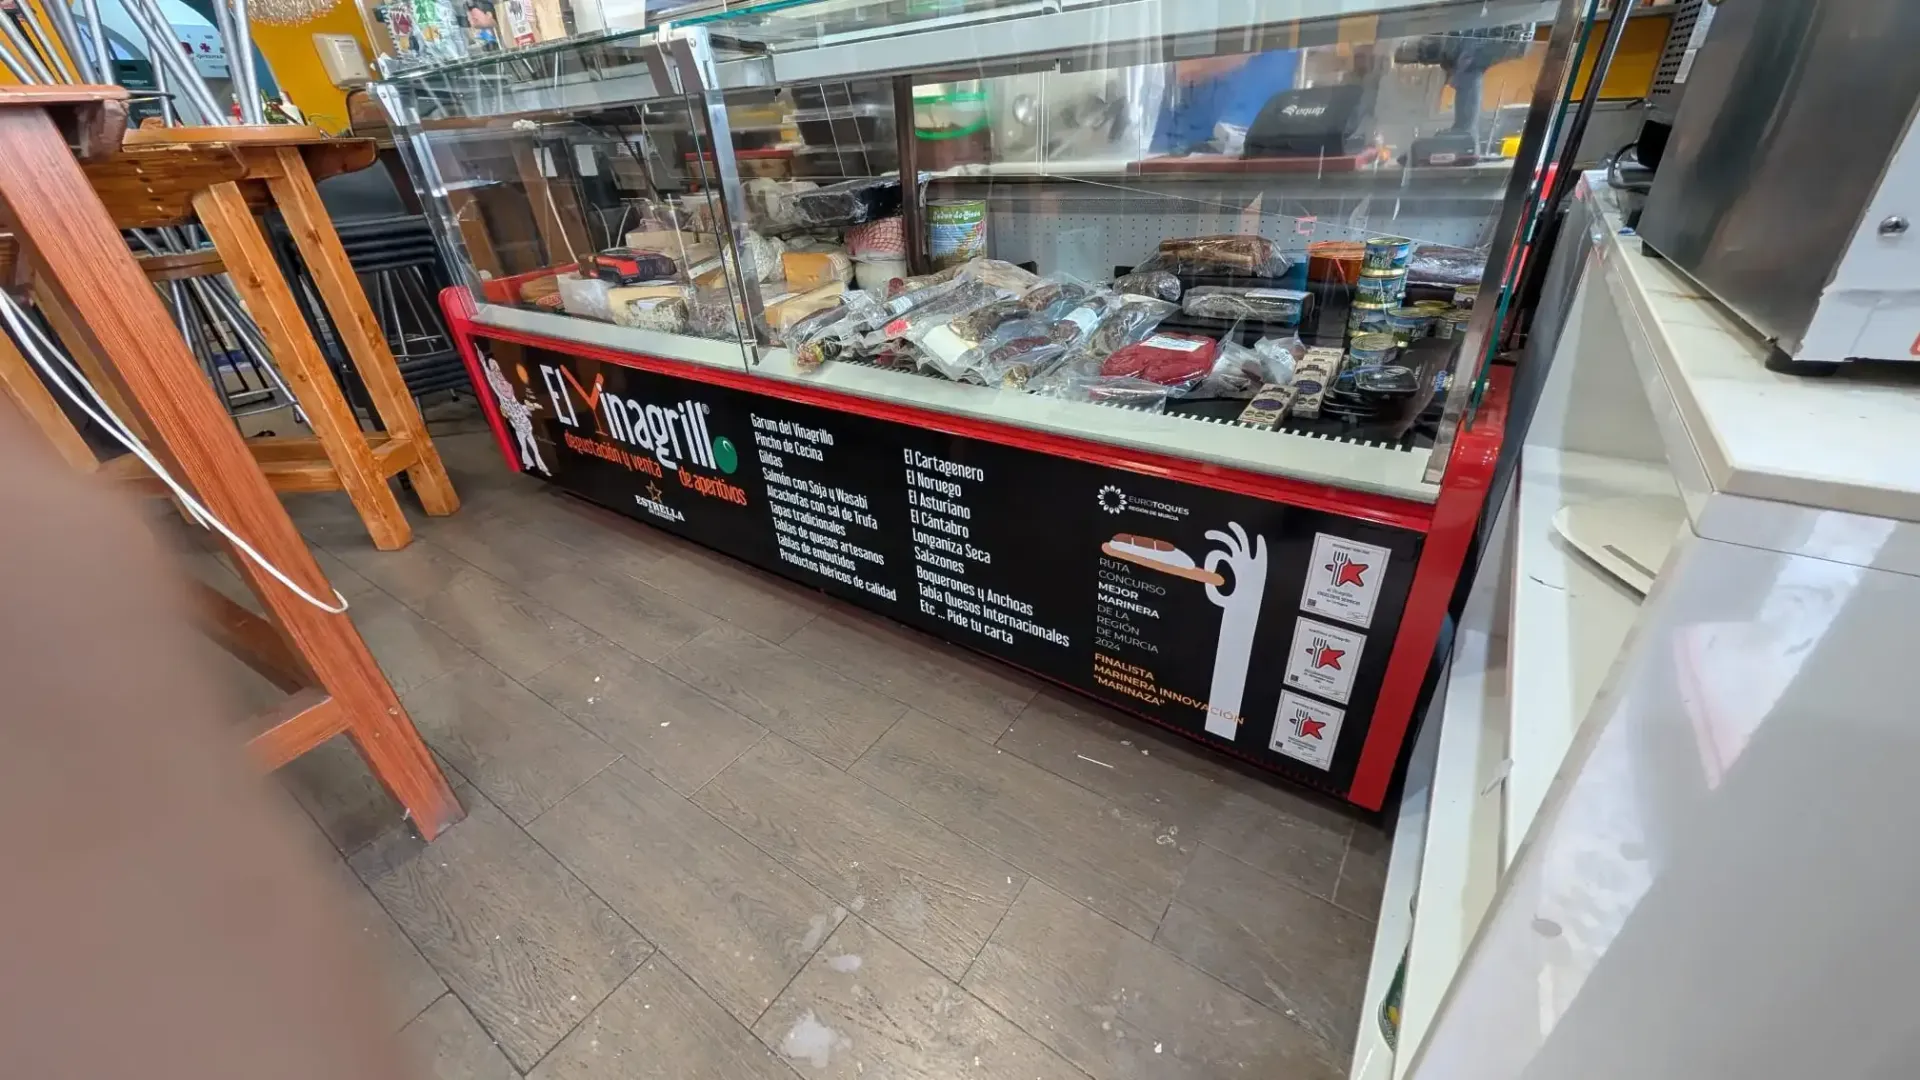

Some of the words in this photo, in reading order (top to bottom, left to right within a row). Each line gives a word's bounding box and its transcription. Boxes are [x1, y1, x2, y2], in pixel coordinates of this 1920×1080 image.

[1296, 105, 1327, 117] equip
[539, 364, 579, 427] El
[750, 412, 778, 432] Garum
[779, 420, 792, 435] del
[792, 422, 834, 446] Vinagrillo
[564, 429, 621, 463] degustación
[621, 450, 632, 471] y
[631, 453, 663, 479] venta
[754, 432, 782, 451] Pincho
[783, 440, 794, 453] de
[794, 442, 824, 462] Cecina
[758, 450, 784, 468] Gildas
[904, 448, 914, 465] El
[915, 450, 984, 482] Cartagenero
[678, 465, 692, 488] de
[693, 475, 747, 506] aperitivos
[762, 467, 792, 487] Salmón
[792, 477, 808, 492] con
[809, 480, 828, 498] Soja
[828, 490, 836, 504] y
[835, 488, 868, 510] Wasabi
[906, 470, 915, 486] El
[917, 472, 962, 498] Noruego
[634, 494, 685, 521] ESTRELLA
[766, 484, 808, 509] Alcachofas
[810, 498, 826, 514] con
[827, 503, 840, 518] sal
[842, 508, 854, 522] de
[854, 510, 878, 530] Trufa
[769, 500, 792, 518] Tapas
[792, 506, 846, 537] tradicionales
[908, 490, 918, 506] El
[920, 492, 971, 520] Asturiano
[1128, 496, 1190, 516] EUROTOQUES
[1158, 512, 1179, 522] MURCIA
[910, 508, 919, 524] El
[921, 512, 970, 539] Cántabro
[772, 516, 797, 536] Tablas
[798, 525, 809, 540] de
[809, 529, 839, 550] quesos
[840, 540, 885, 566] artesanos
[776, 532, 800, 550] Tablas
[801, 541, 812, 554] de
[812, 546, 856, 572] embutidos
[912, 528, 963, 556] Longaniza
[965, 544, 991, 564] Seca
[779, 548, 818, 572] Productos
[819, 562, 852, 586] ibéricos
[853, 576, 864, 590] de
[865, 580, 897, 602] calidad
[914, 546, 964, 574] Salazones
[1100, 557, 1130, 574] RUTA
[916, 565, 975, 596] Boquerones
[977, 587, 985, 602] y
[987, 588, 1034, 616] Anchoas
[1098, 570, 1166, 596] CONCURSO
[1098, 582, 1138, 600] MEJOR
[918, 582, 942, 602] Tabla
[944, 591, 981, 616] Quesos
[983, 605, 1070, 648] Internacionales
[1098, 593, 1160, 620] MARINERA
[1098, 604, 1113, 616] DE
[1115, 609, 1130, 622] LA
[920, 600, 936, 616] Etc
[947, 609, 968, 628] Pide
[970, 618, 982, 633] tu
[984, 624, 1014, 645] carta
[1096, 616, 1140, 636] REGIÓN
[1095, 636, 1121, 652] 2024
[1096, 626, 1112, 640] DE
[1114, 632, 1158, 654] MURCIA
[1094, 652, 1154, 681] FINALISTA
[1094, 663, 1156, 694] MARINERA
[1160, 687, 1244, 726] INNOVACIÓN
